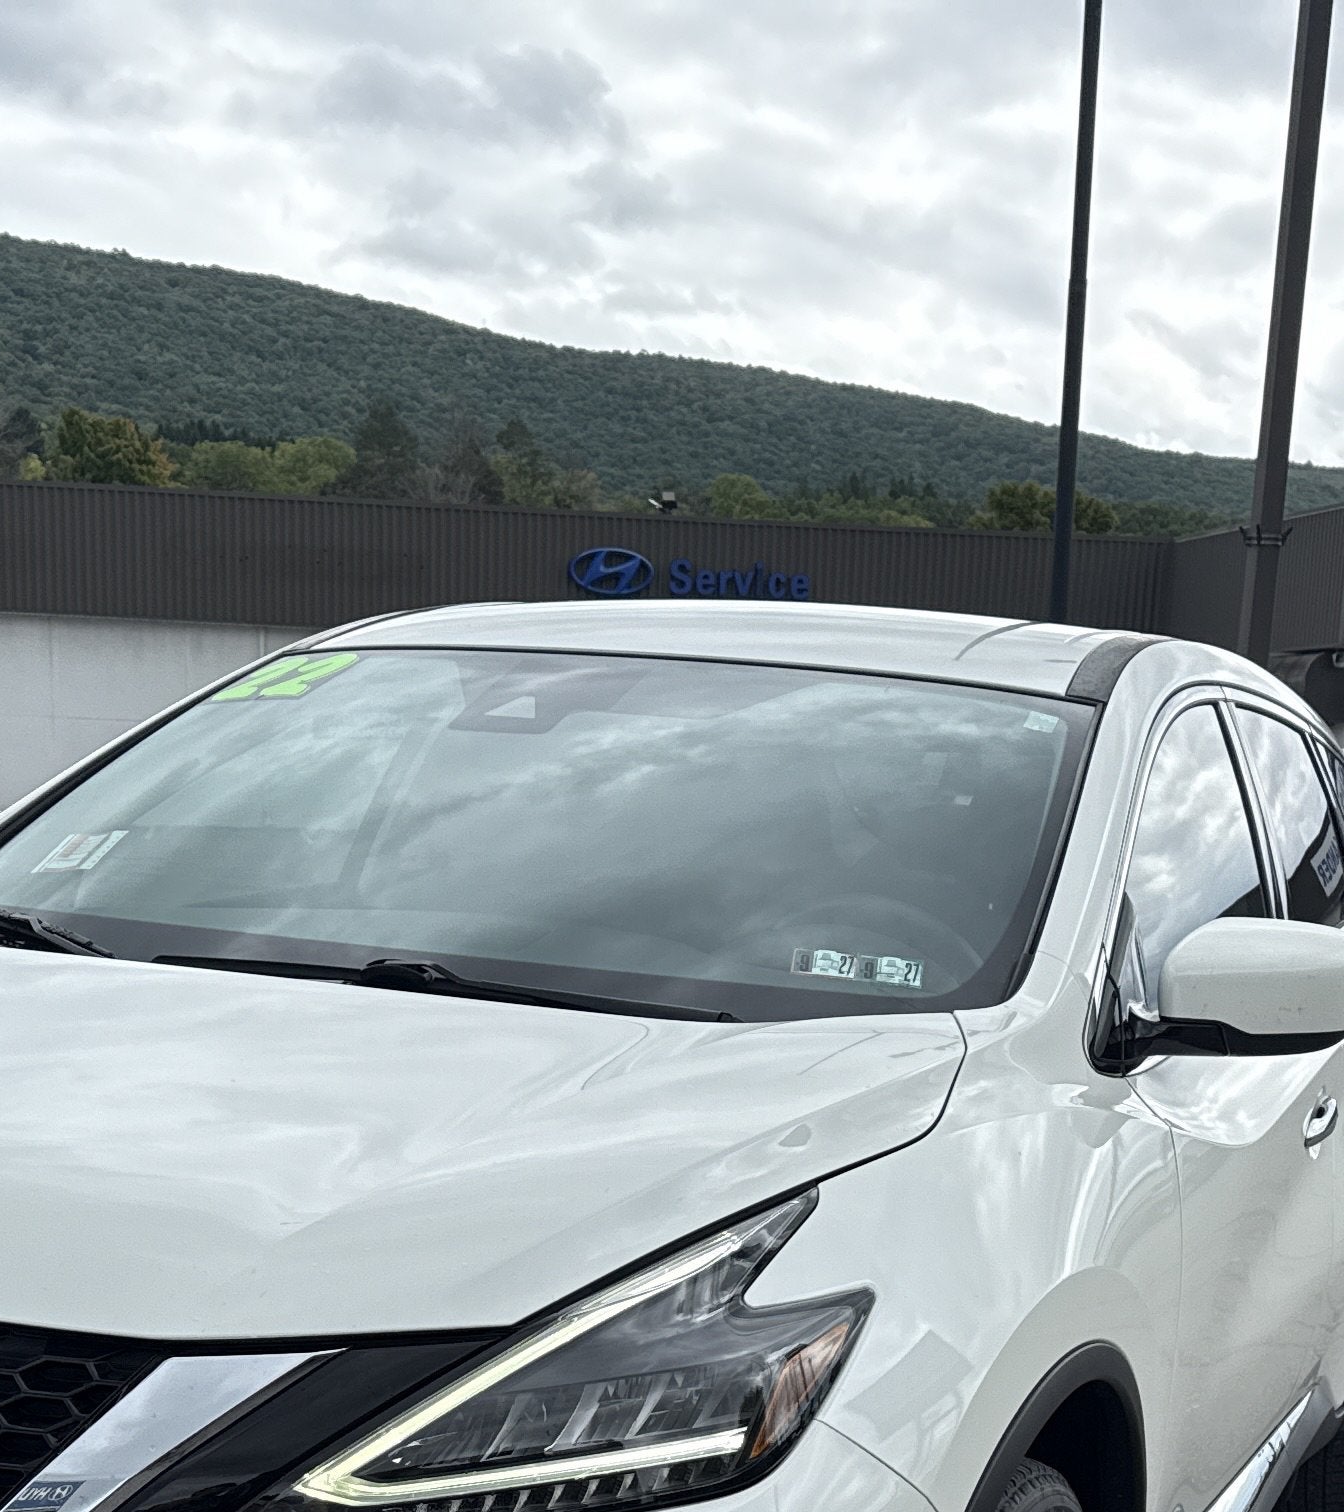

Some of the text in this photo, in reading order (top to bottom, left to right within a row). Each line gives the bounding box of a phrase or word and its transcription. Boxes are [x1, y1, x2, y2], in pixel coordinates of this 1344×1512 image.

[669, 558, 811, 600] Service
[211, 652, 360, 701] 22
[799, 954, 855, 976] 9 27
[863, 961, 920, 983] 9 27
